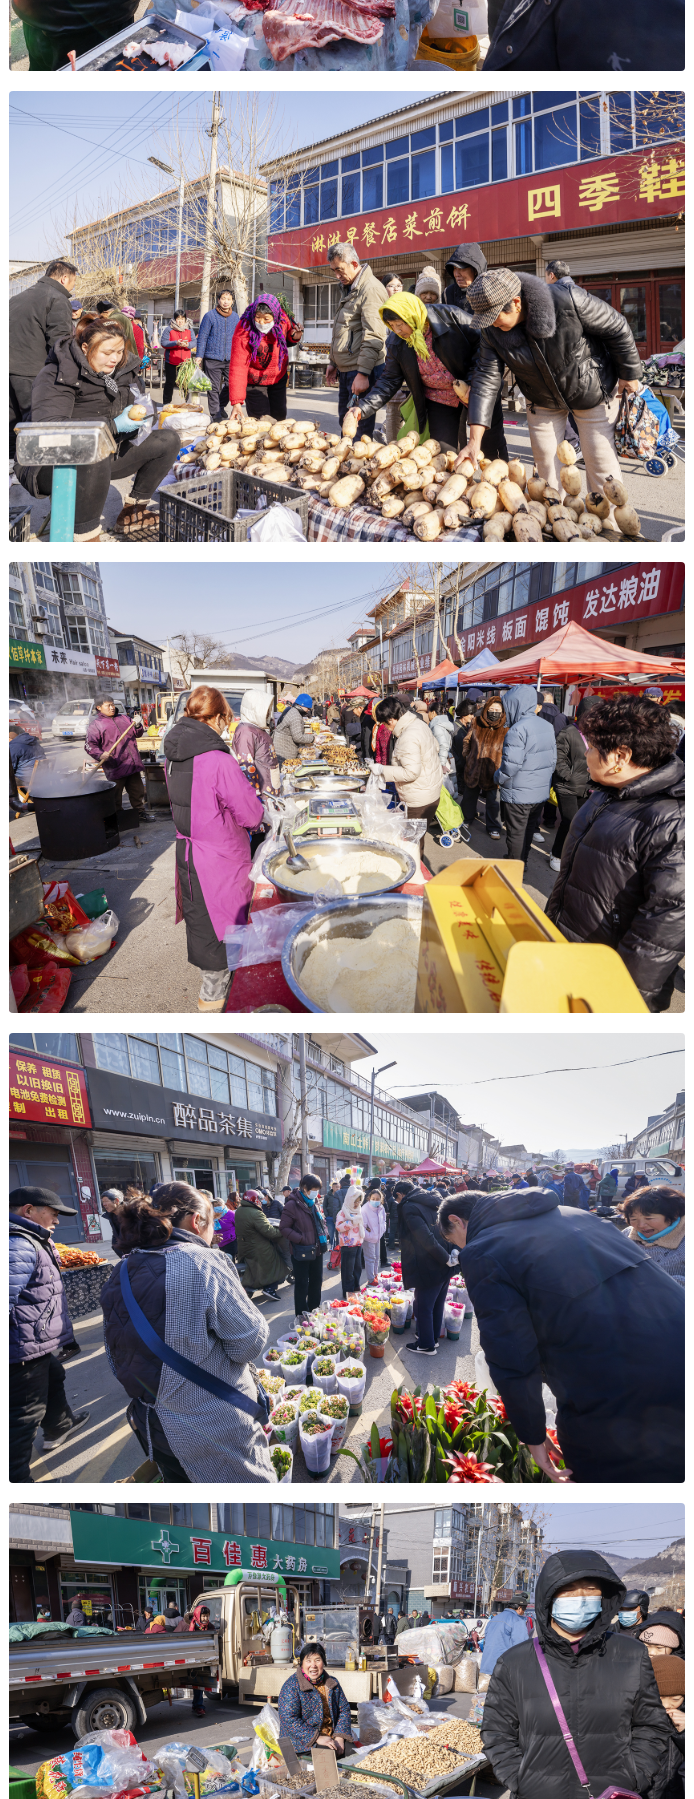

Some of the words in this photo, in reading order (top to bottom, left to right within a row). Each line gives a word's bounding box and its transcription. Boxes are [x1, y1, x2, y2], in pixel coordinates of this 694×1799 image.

[528, 158, 685, 221] 四季鞋
[501, 614, 528, 642] 板面
[535, 601, 570, 634] 馄饨
[583, 568, 661, 619] 发达粮油
[51, 650, 68, 666] 未来
[15, 1059, 37, 1074] 保养
[41, 1066, 62, 1081] 租赁
[16, 1074, 63, 1093] 以旧换旧
[9, 1086, 67, 1107] 电池免费检测
[45, 1106, 69, 1120] 出租
[103, 1107, 166, 1125] www.zuipin.cn
[172, 1101, 253, 1138] 醉品茶集
[190, 1536, 268, 1568] 百佳惠
[273, 1553, 307, 1573] 大药房
